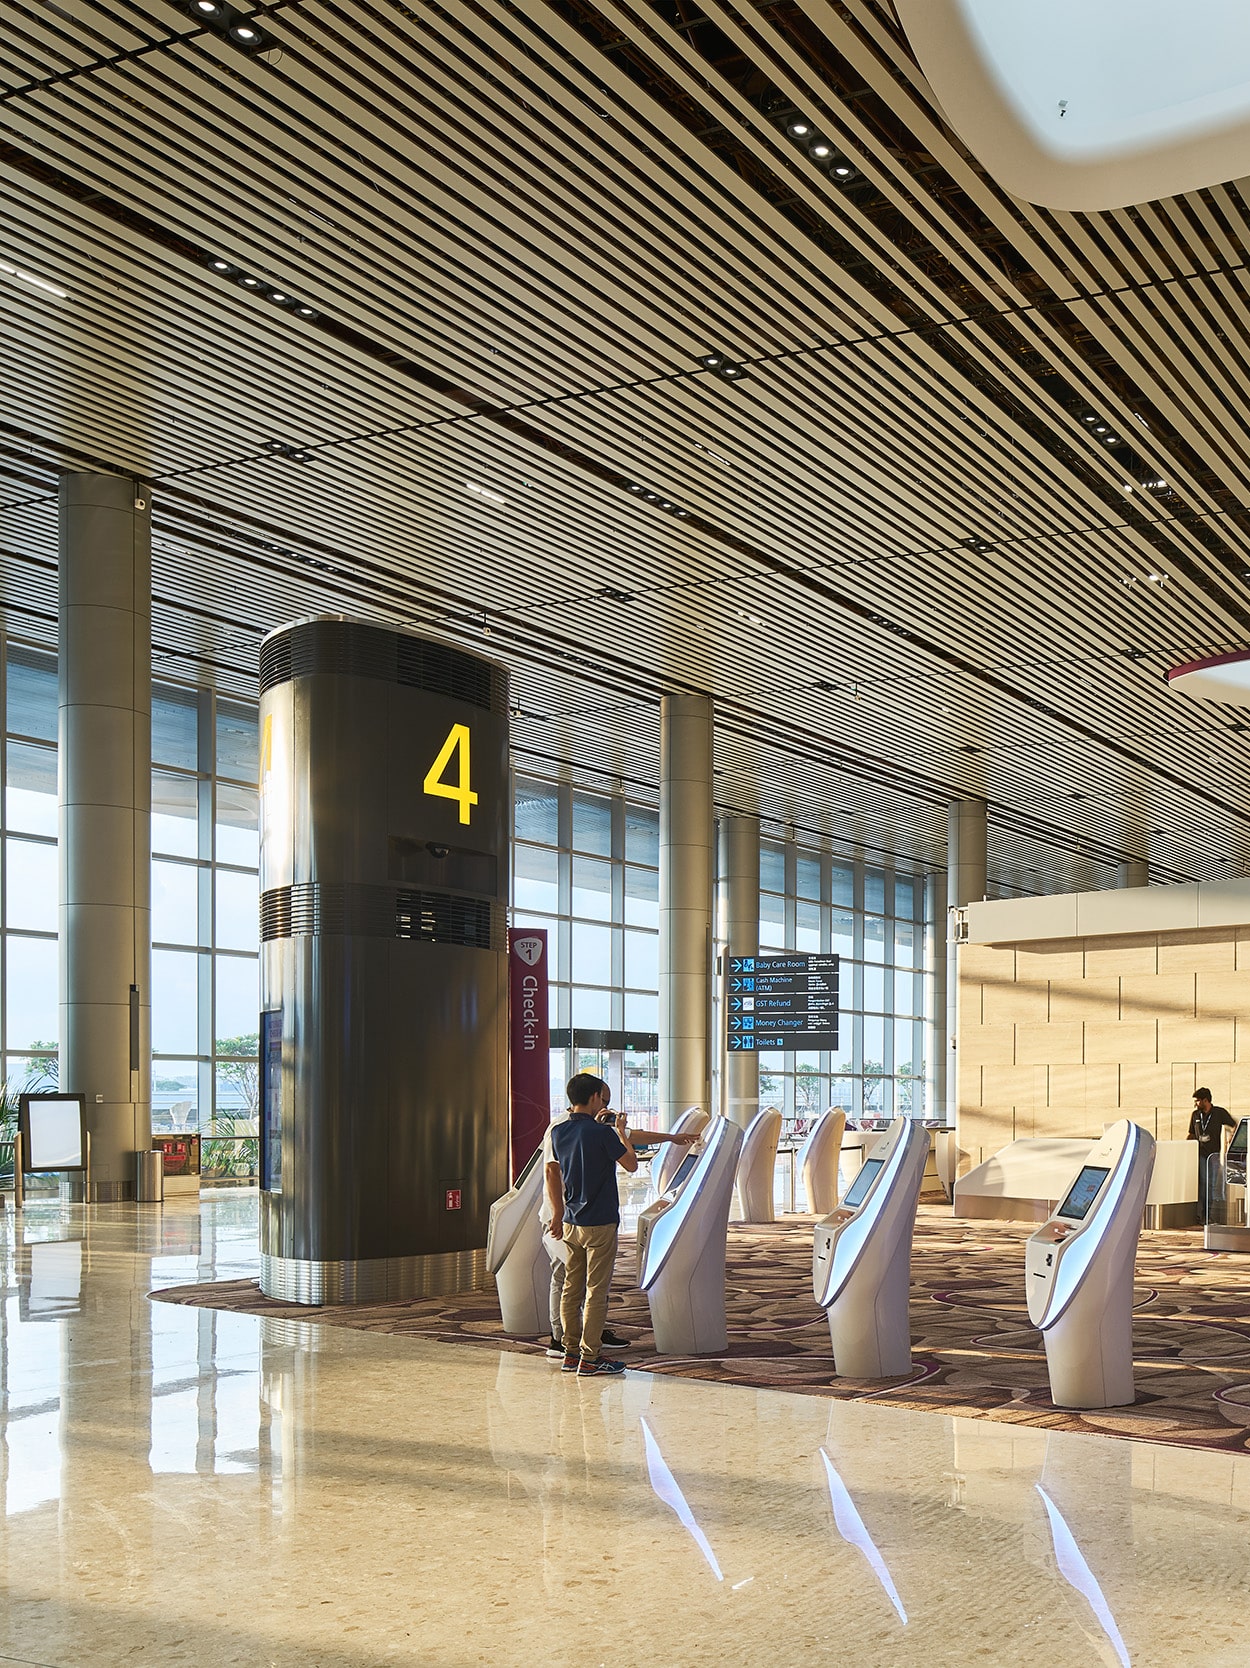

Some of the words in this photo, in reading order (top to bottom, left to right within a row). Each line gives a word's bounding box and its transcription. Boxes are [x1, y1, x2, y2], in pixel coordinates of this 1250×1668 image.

[423, 722, 479, 826] 4
[521, 941, 537, 949] STEP
[525, 949, 532, 960] 1
[755, 961, 771, 969] Baby
[772, 960, 785, 969] Care
[787, 959, 806, 968] Room
[755, 984, 773, 992] (ATM)
[522, 975, 539, 1050] Check-in
[755, 1019, 776, 1028] Money
[777, 1019, 803, 1028] Changer
[755, 1038, 776, 1046] Toilets
